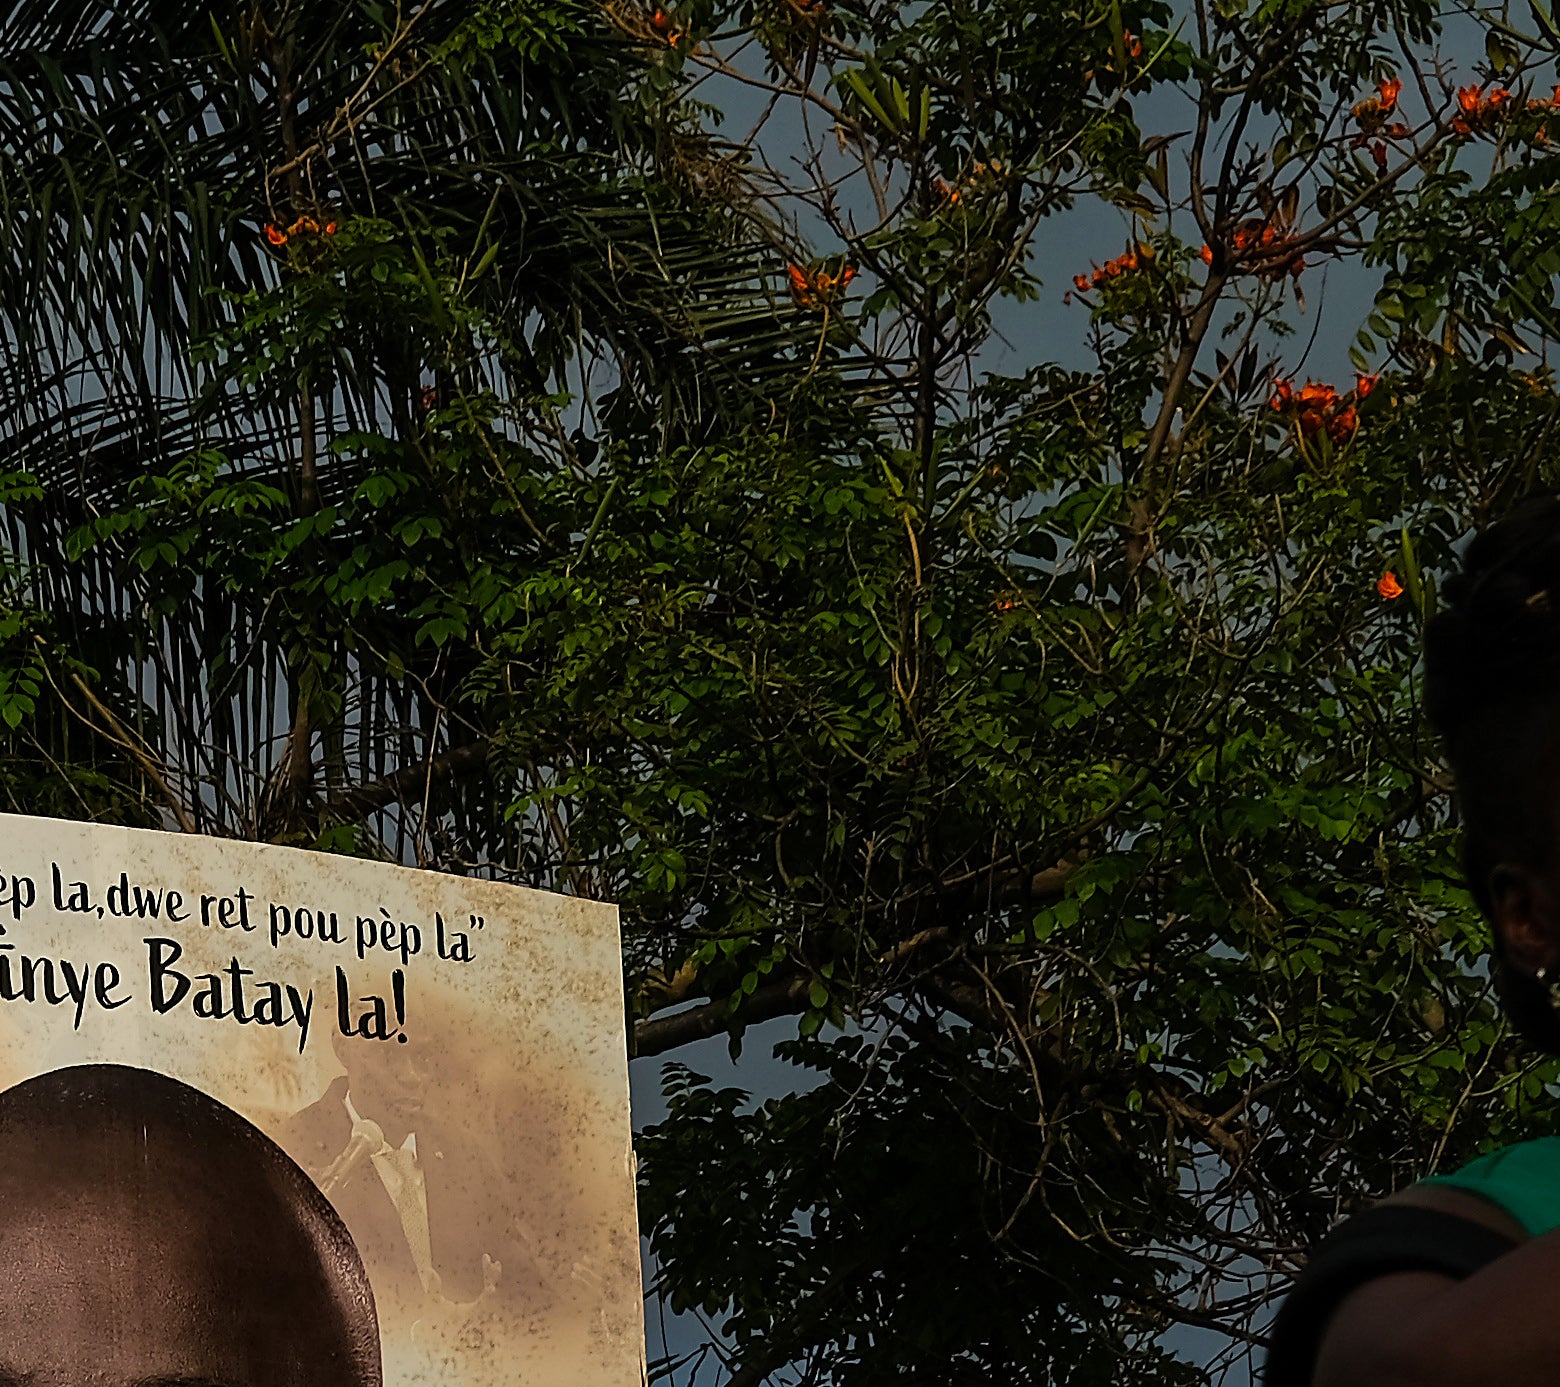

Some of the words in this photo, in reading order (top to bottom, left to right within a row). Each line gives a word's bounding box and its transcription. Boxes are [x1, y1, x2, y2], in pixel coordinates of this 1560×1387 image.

[200, 887, 257, 932] ret
[269, 902, 347, 948] pou
[356, 907, 422, 965] pèp
[143, 937, 314, 1054] Batay
[336, 964, 409, 1044] la!
